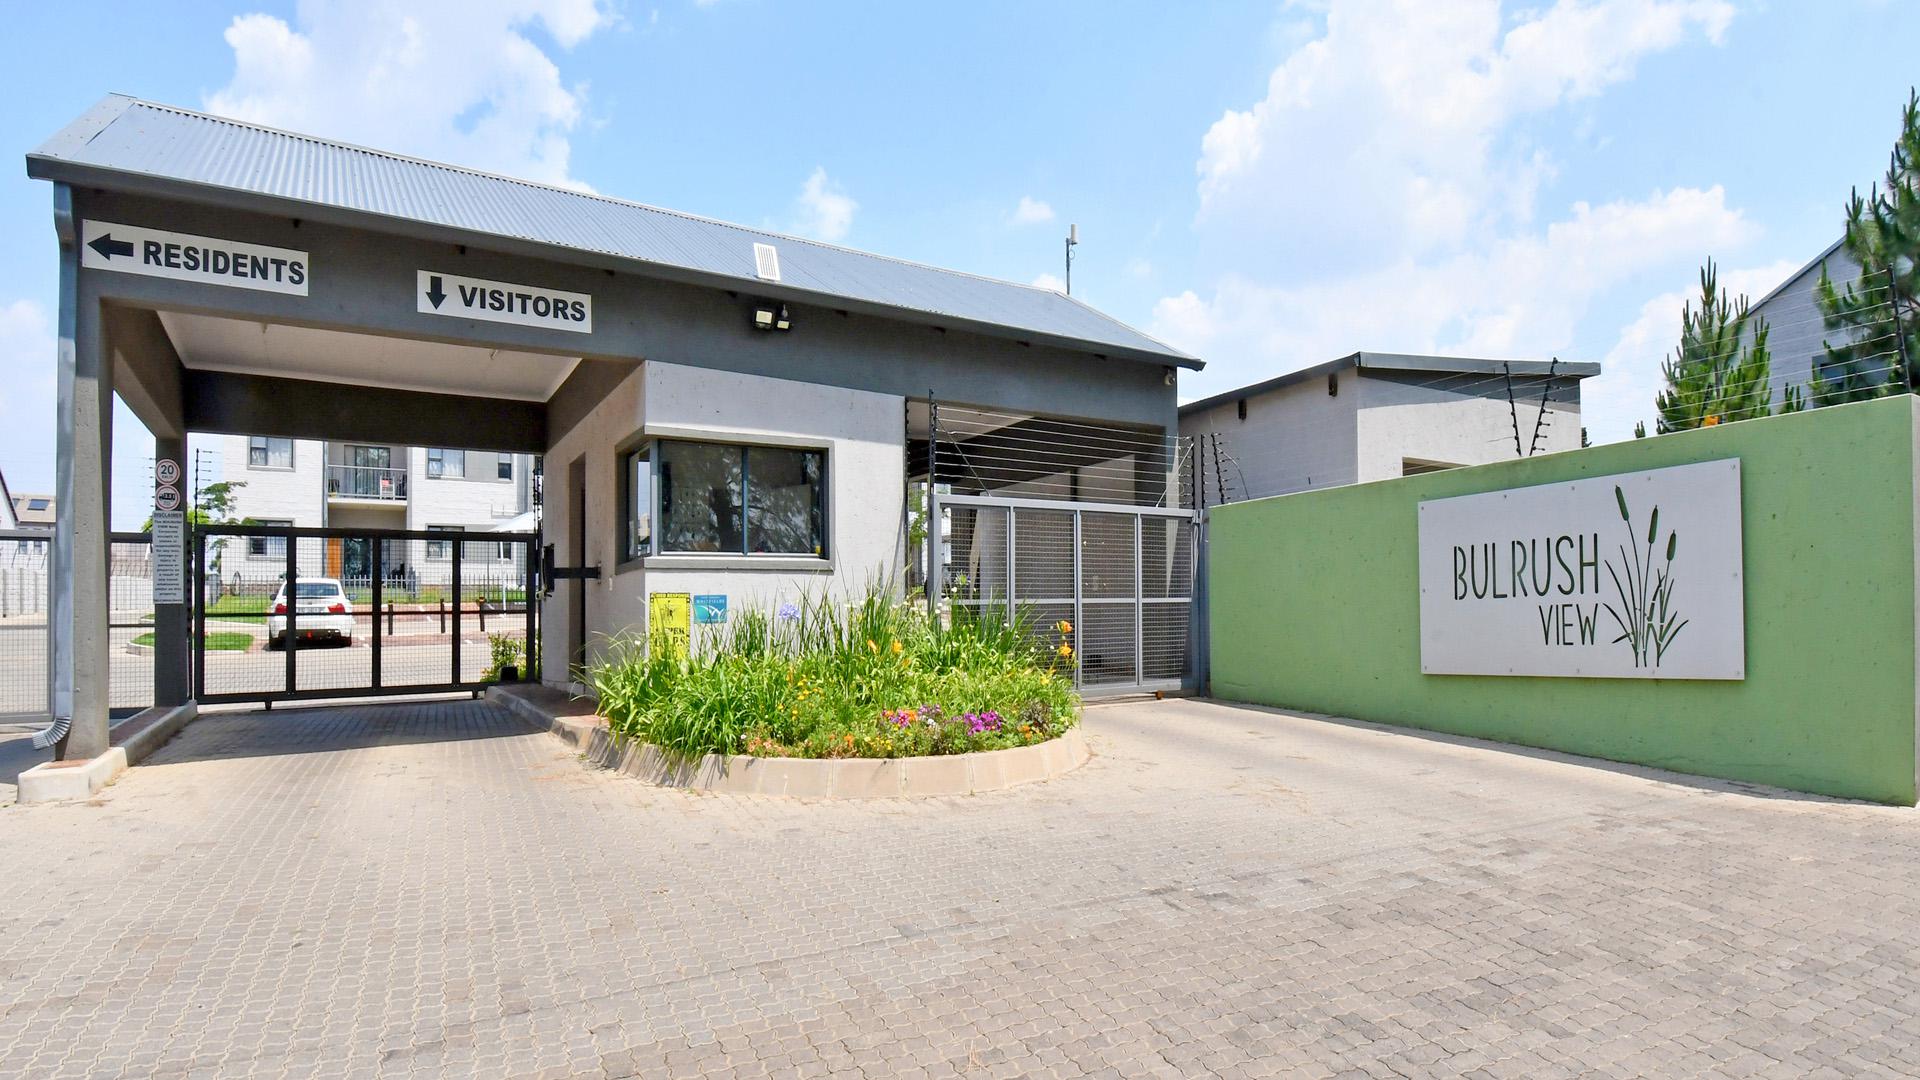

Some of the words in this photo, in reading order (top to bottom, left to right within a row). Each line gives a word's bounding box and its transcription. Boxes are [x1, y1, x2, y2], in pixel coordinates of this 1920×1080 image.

[143, 240, 305, 285] RESIDENTS
[458, 284, 586, 322] VISITORS
[160, 464, 175, 475] 20
[1454, 533, 1599, 601] BULRUSH
[1538, 603, 1599, 646] VIEW
